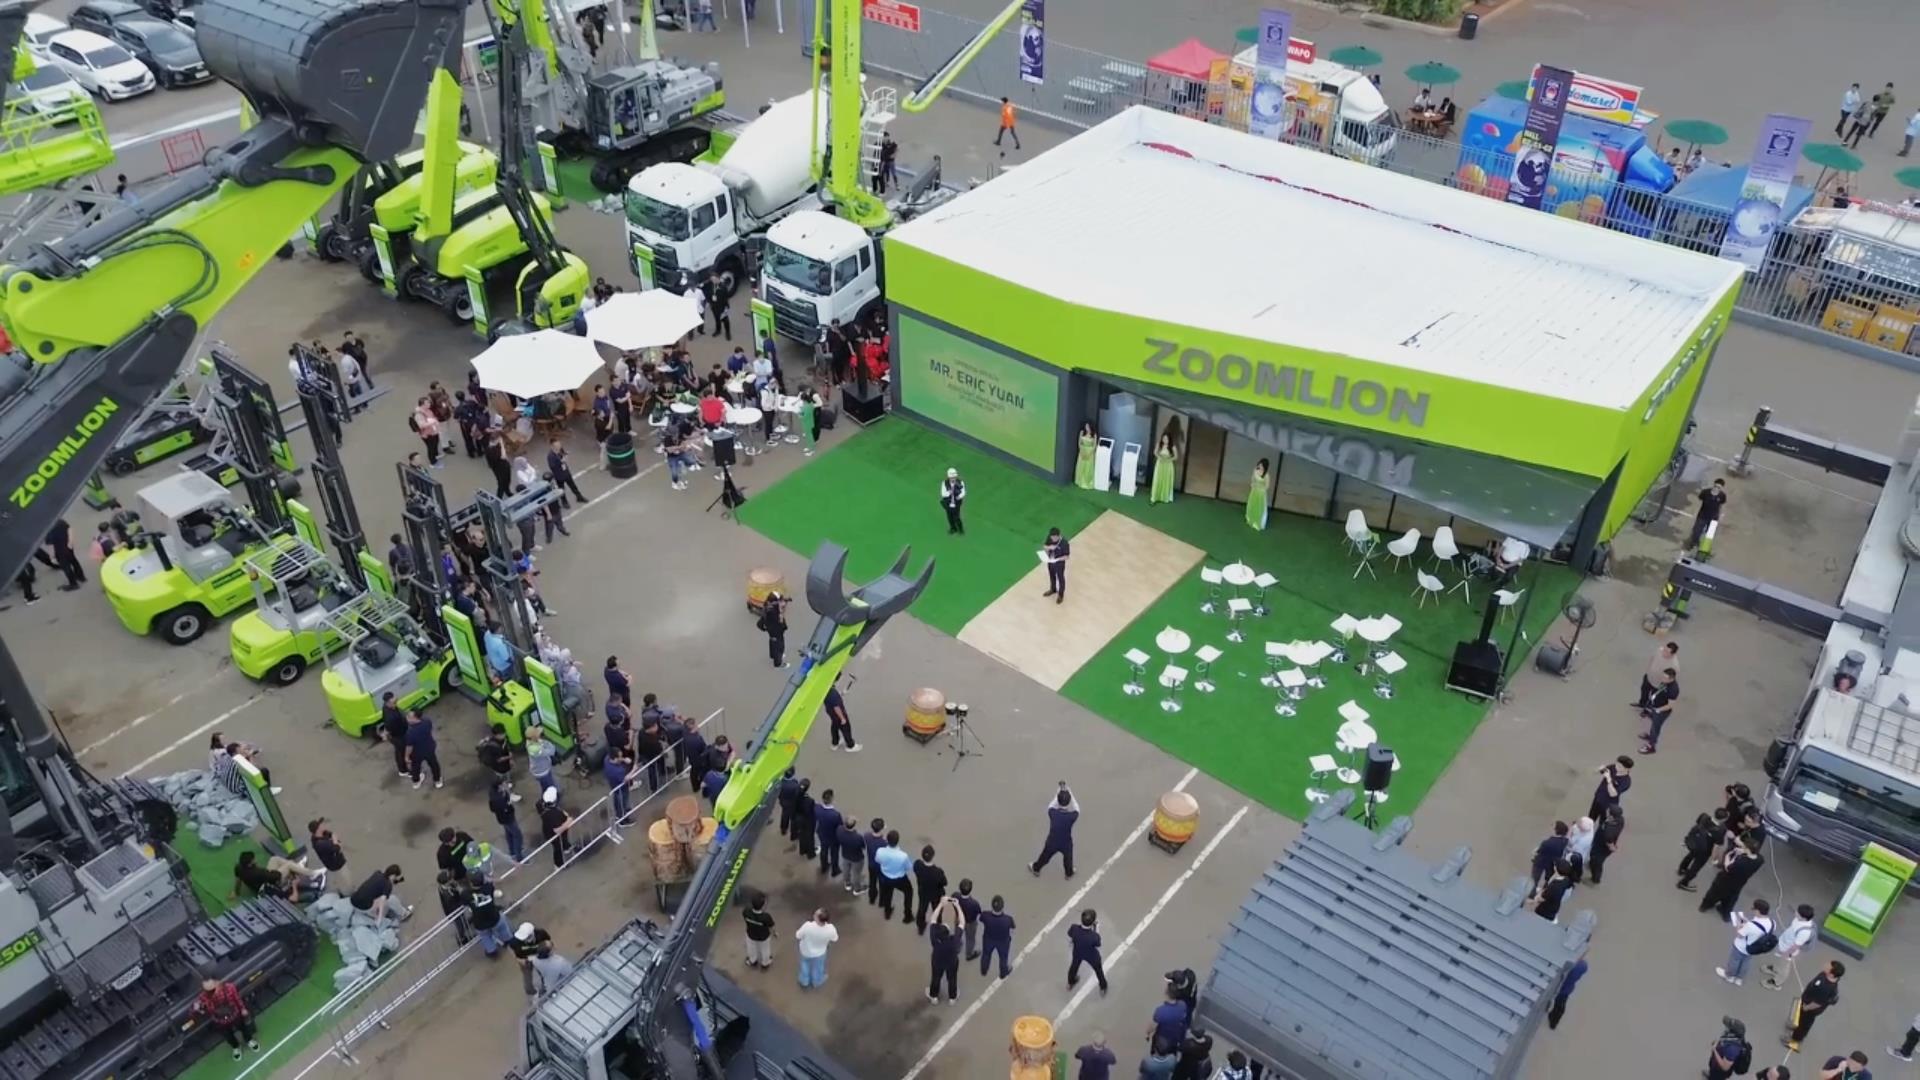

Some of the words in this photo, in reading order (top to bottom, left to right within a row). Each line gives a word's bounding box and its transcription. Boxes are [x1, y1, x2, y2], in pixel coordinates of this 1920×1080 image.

[930, 359, 953, 379] MR.
[957, 371, 986, 393] ERIC
[989, 384, 1024, 409] YUAN
[1143, 338, 1431, 427] ZOOMLION
[9, 397, 119, 508] ZOOMLION
[705, 848, 749, 928] ZOOMLION
